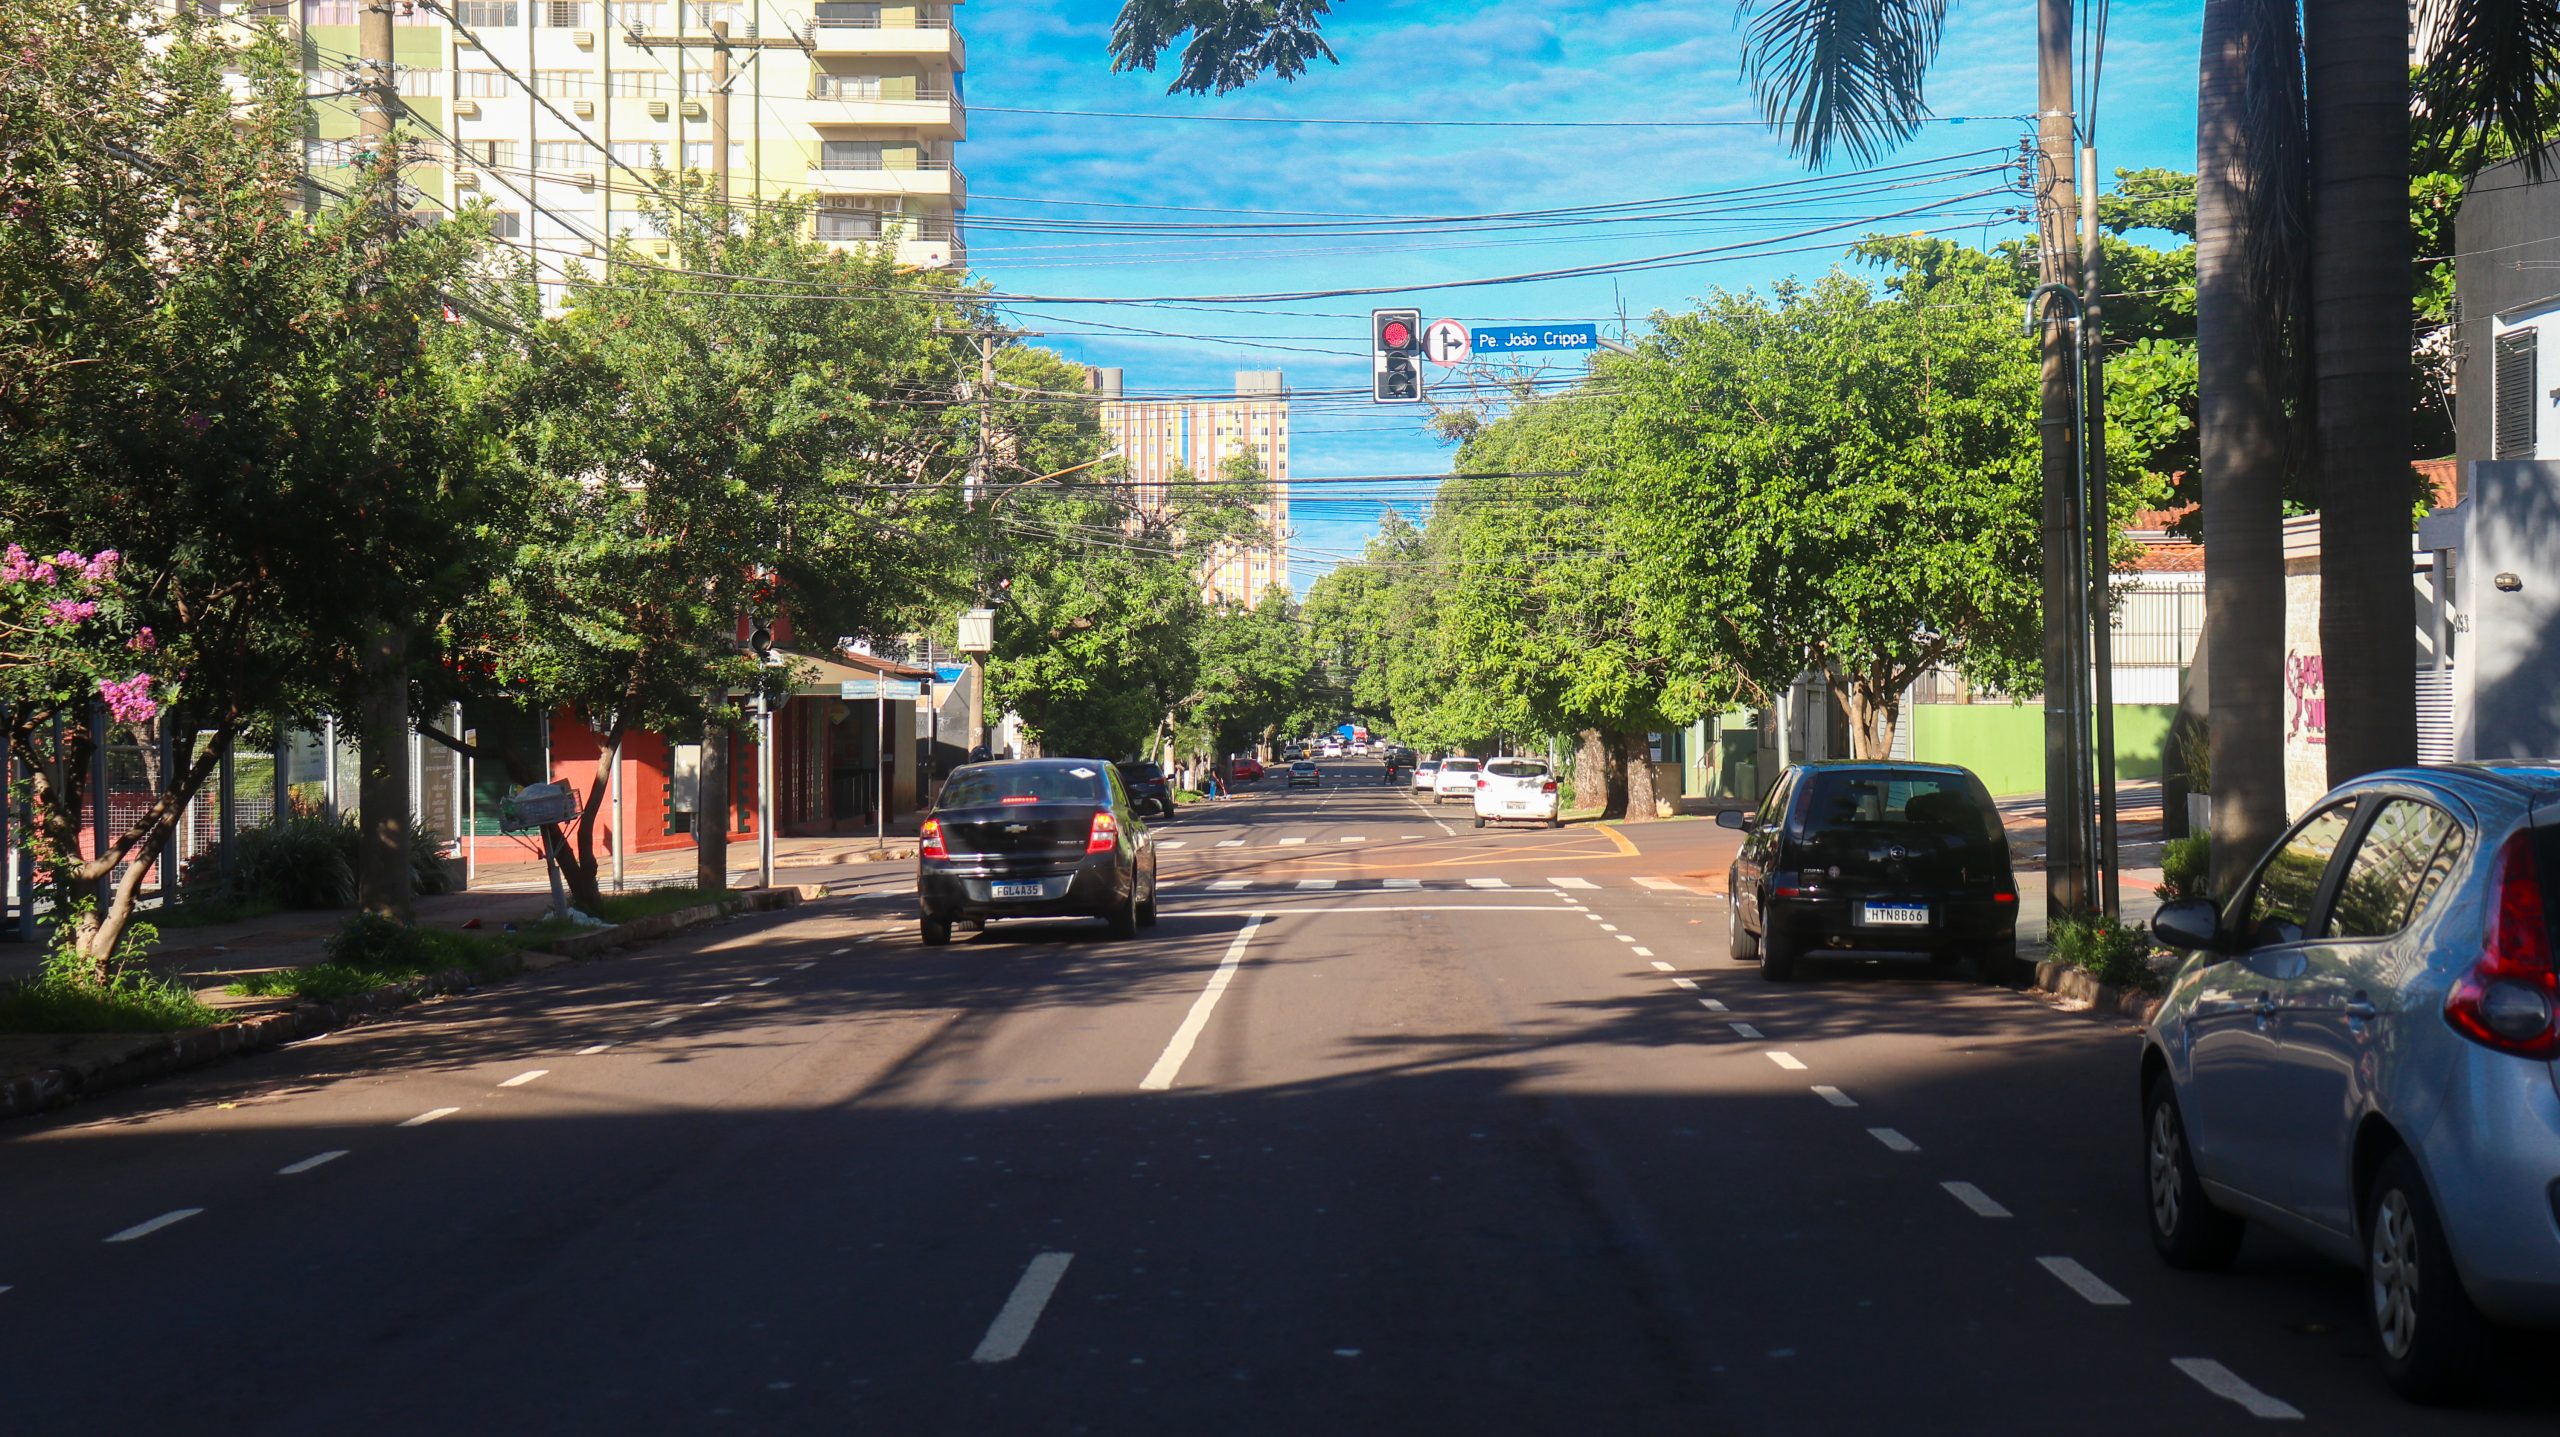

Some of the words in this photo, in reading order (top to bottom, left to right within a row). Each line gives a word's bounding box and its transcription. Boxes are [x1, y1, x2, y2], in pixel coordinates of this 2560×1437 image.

[1479, 333, 1499, 348] Pe.
[1504, 332, 1538, 347] João
[1543, 331, 1588, 348] Crippa
[997, 885, 1038, 896] FGL4A35
[1871, 909, 1923, 922] HTN8B66
